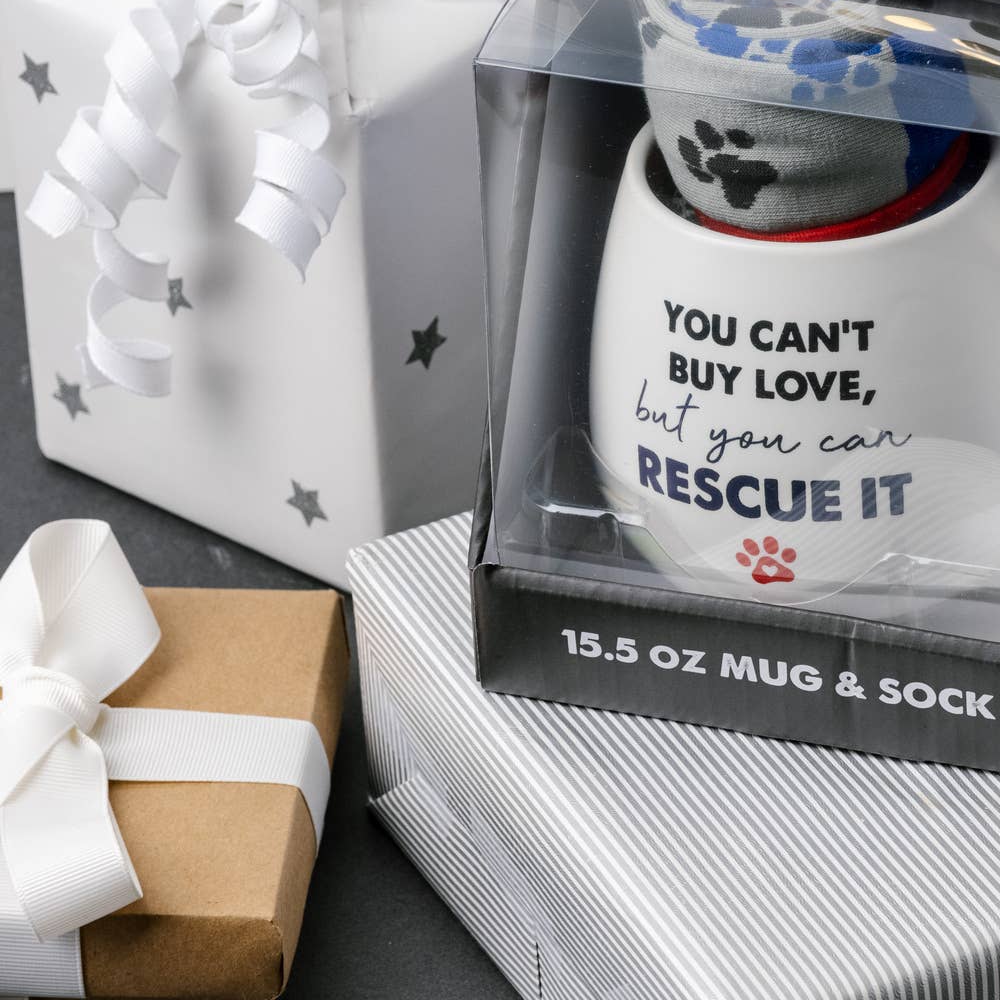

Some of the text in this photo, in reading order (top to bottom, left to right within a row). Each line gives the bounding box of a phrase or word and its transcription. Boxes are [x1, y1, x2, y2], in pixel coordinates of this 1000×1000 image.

[664, 300, 874, 353] YOU CAN'T
[669, 351, 876, 406] BUY LOVE,
[635, 378, 912, 464] but you can
[637, 444, 912, 522] RESCUE IT
[561, 628, 638, 664] 15.5
[649, 644, 707, 674] OZ
[719, 652, 823, 693] MUG
[835, 670, 867, 700] &
[878, 677, 996, 720] SOCK
